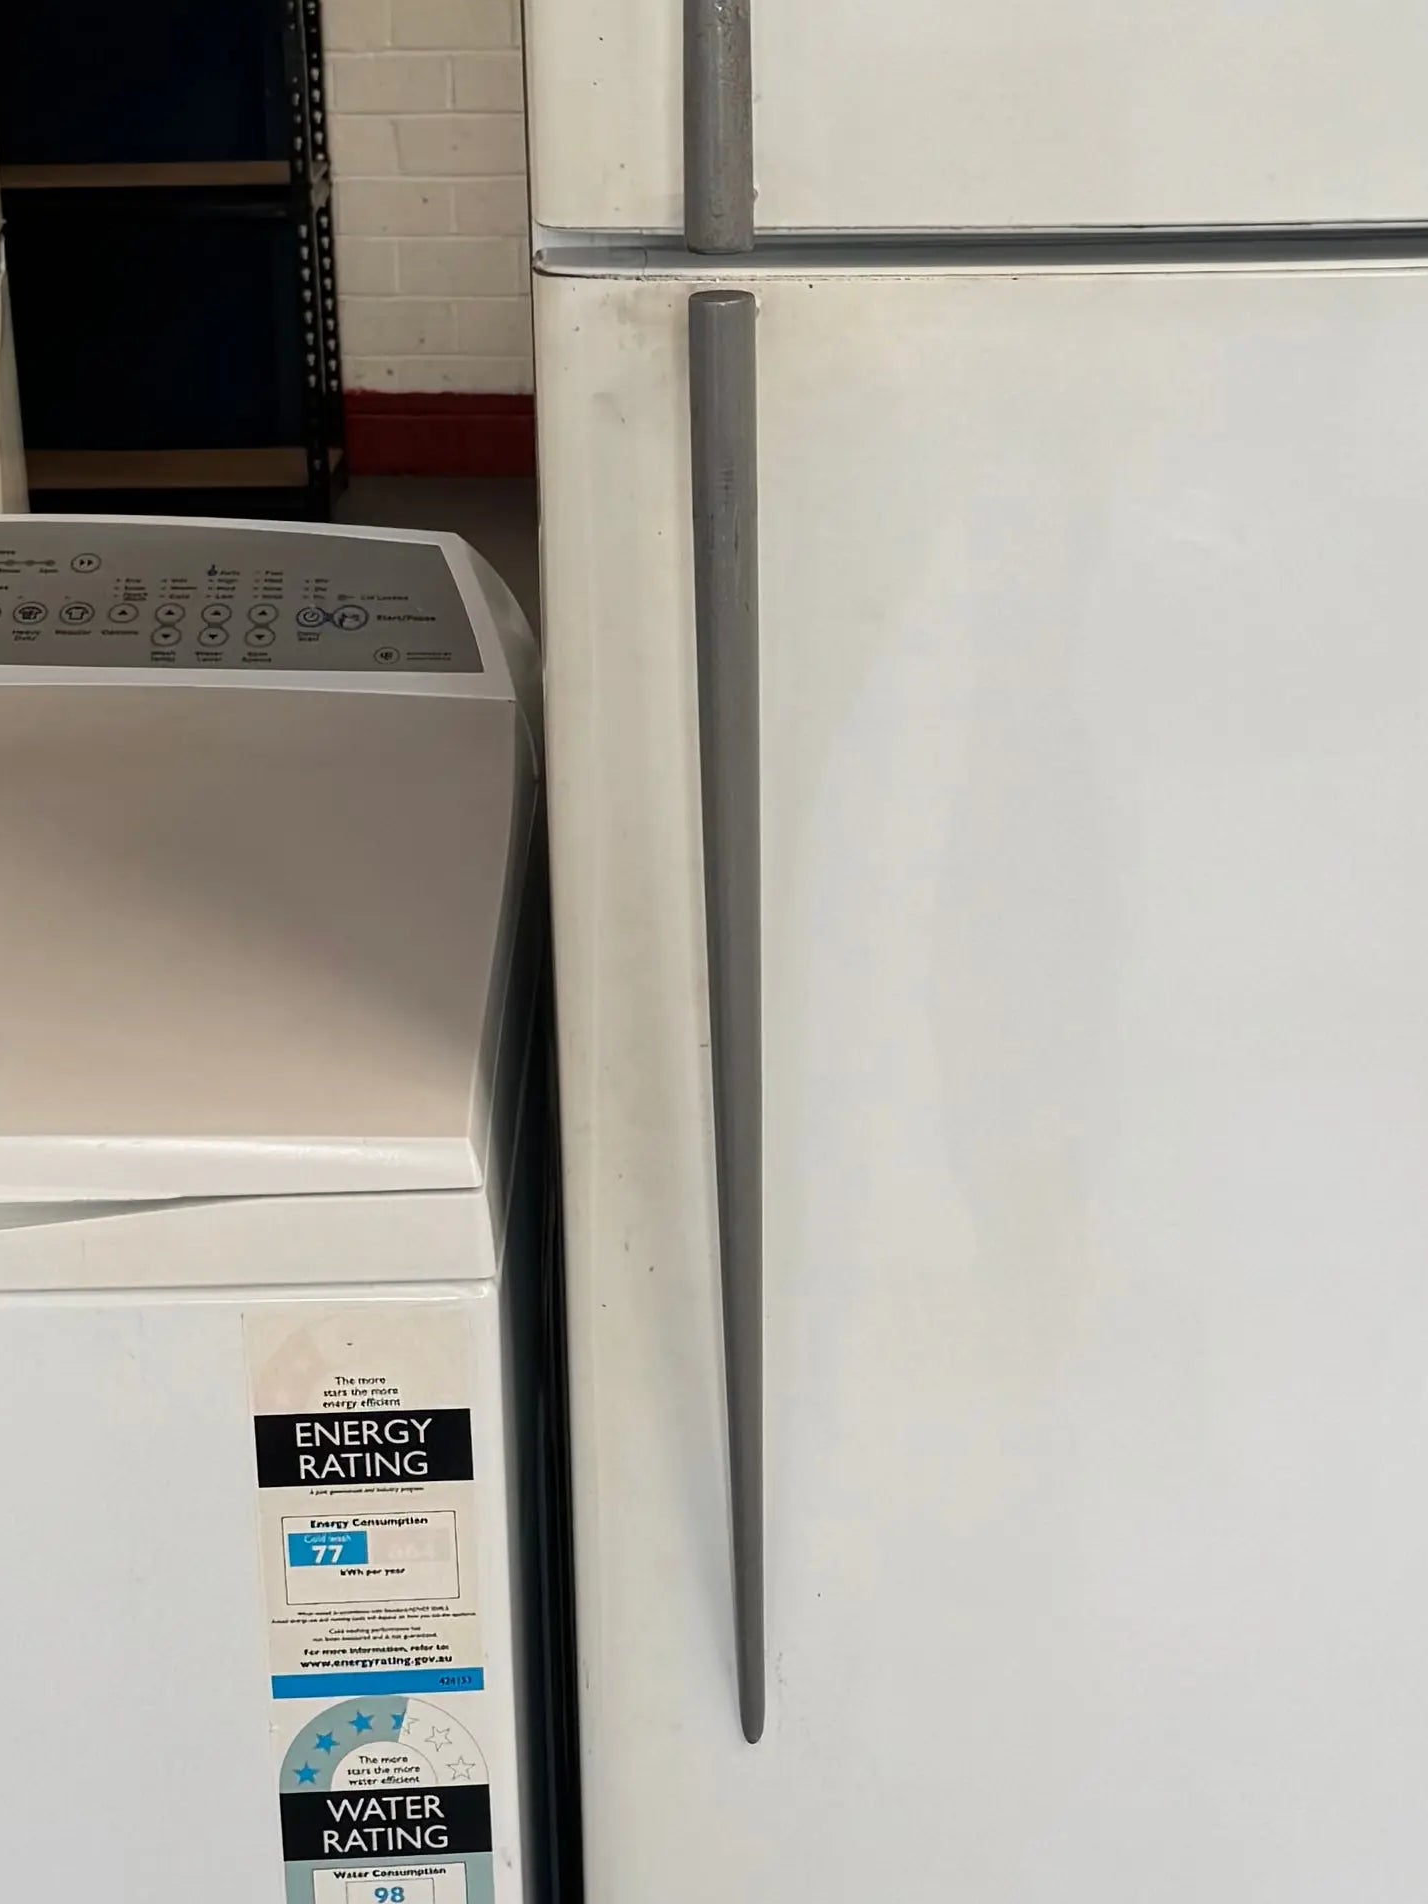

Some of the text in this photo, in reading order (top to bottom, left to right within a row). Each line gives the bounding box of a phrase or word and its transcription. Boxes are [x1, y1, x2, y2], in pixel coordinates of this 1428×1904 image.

[334, 1376, 356, 1385] The
[295, 1418, 432, 1448] ENERGY
[299, 1451, 429, 1479] RATING
[310, 1517, 429, 1529] Energy Consumption
[312, 1544, 344, 1564] 77
[300, 1654, 453, 1668] www.energyrating.gov.au
[358, 1755, 378, 1764] The
[326, 1795, 445, 1822] WATER
[323, 1825, 449, 1854] RATING
[334, 1867, 446, 1879] Water Consumption
[374, 1886, 405, 1903] 98
